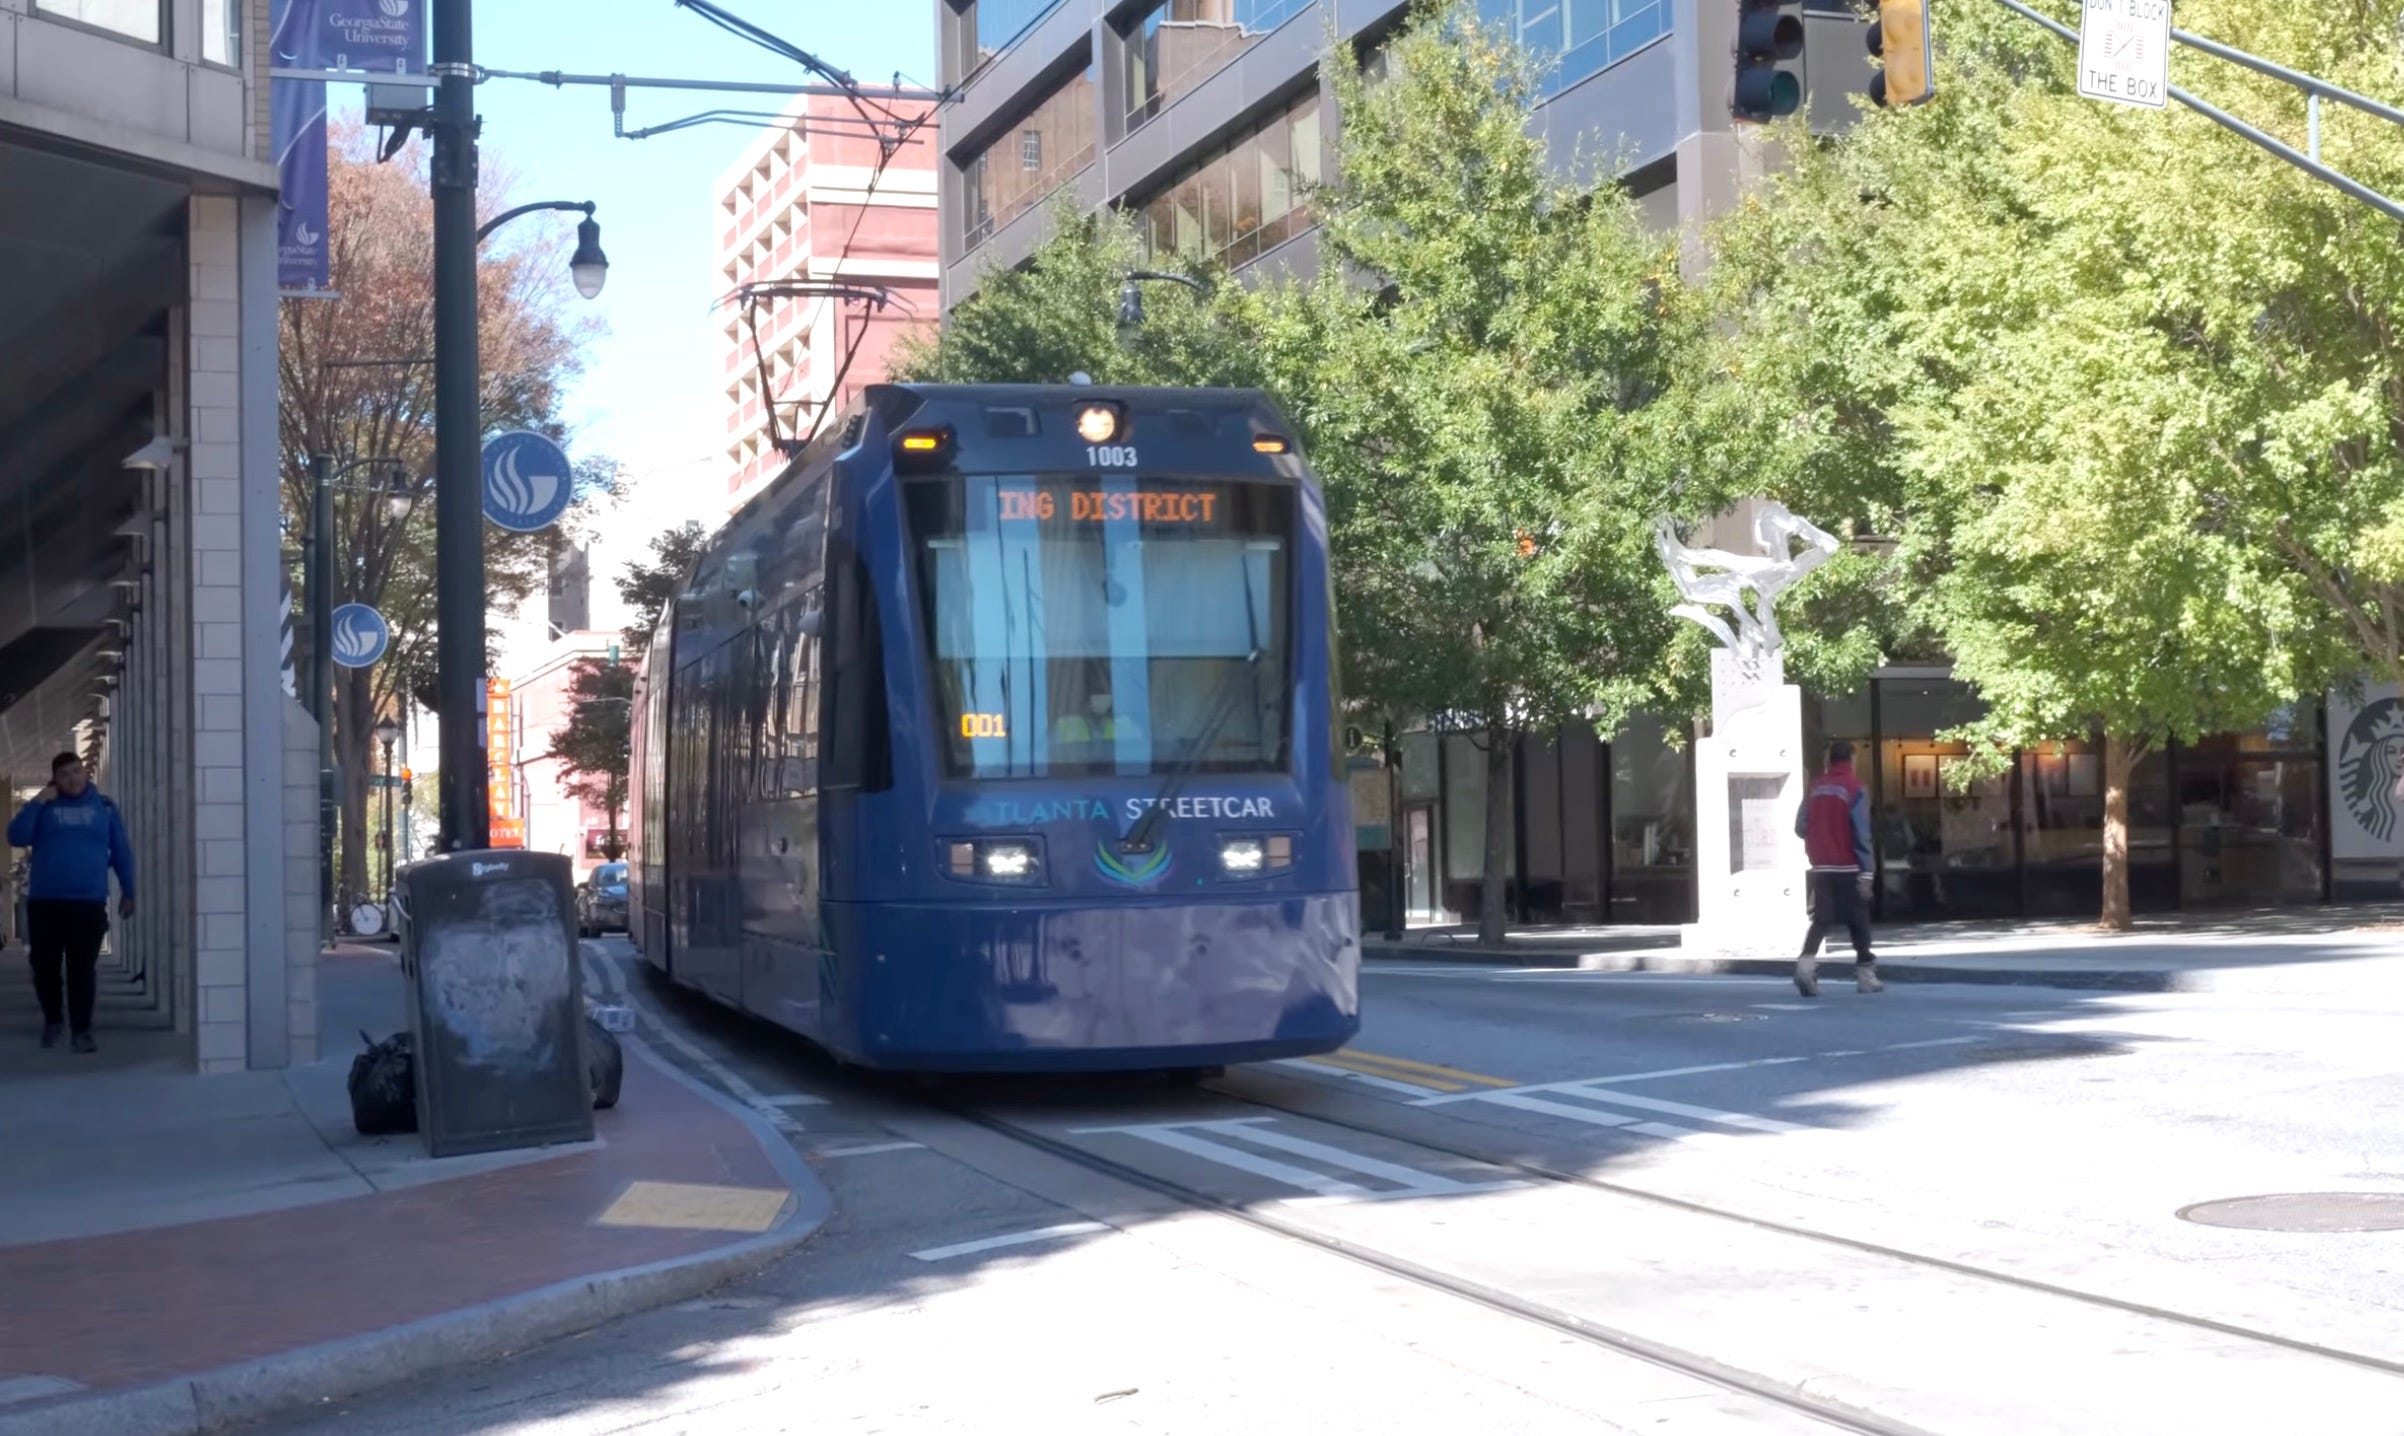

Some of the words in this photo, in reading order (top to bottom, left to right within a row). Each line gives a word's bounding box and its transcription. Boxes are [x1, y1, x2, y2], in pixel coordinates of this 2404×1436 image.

[2129, 0, 2165, 21] BLOCK
[344, 28, 409, 51] University
[2088, 69, 2118, 93] THE
[2127, 77, 2158, 99] BOX
[1086, 446, 1138, 468] 1003
[998, 492, 1054, 521] ING
[1071, 492, 1216, 521] DISTRICT
[961, 713, 1006, 737] 001
[493, 700, 506, 816] BARCLAY
[978, 799, 1110, 823] TLANTA
